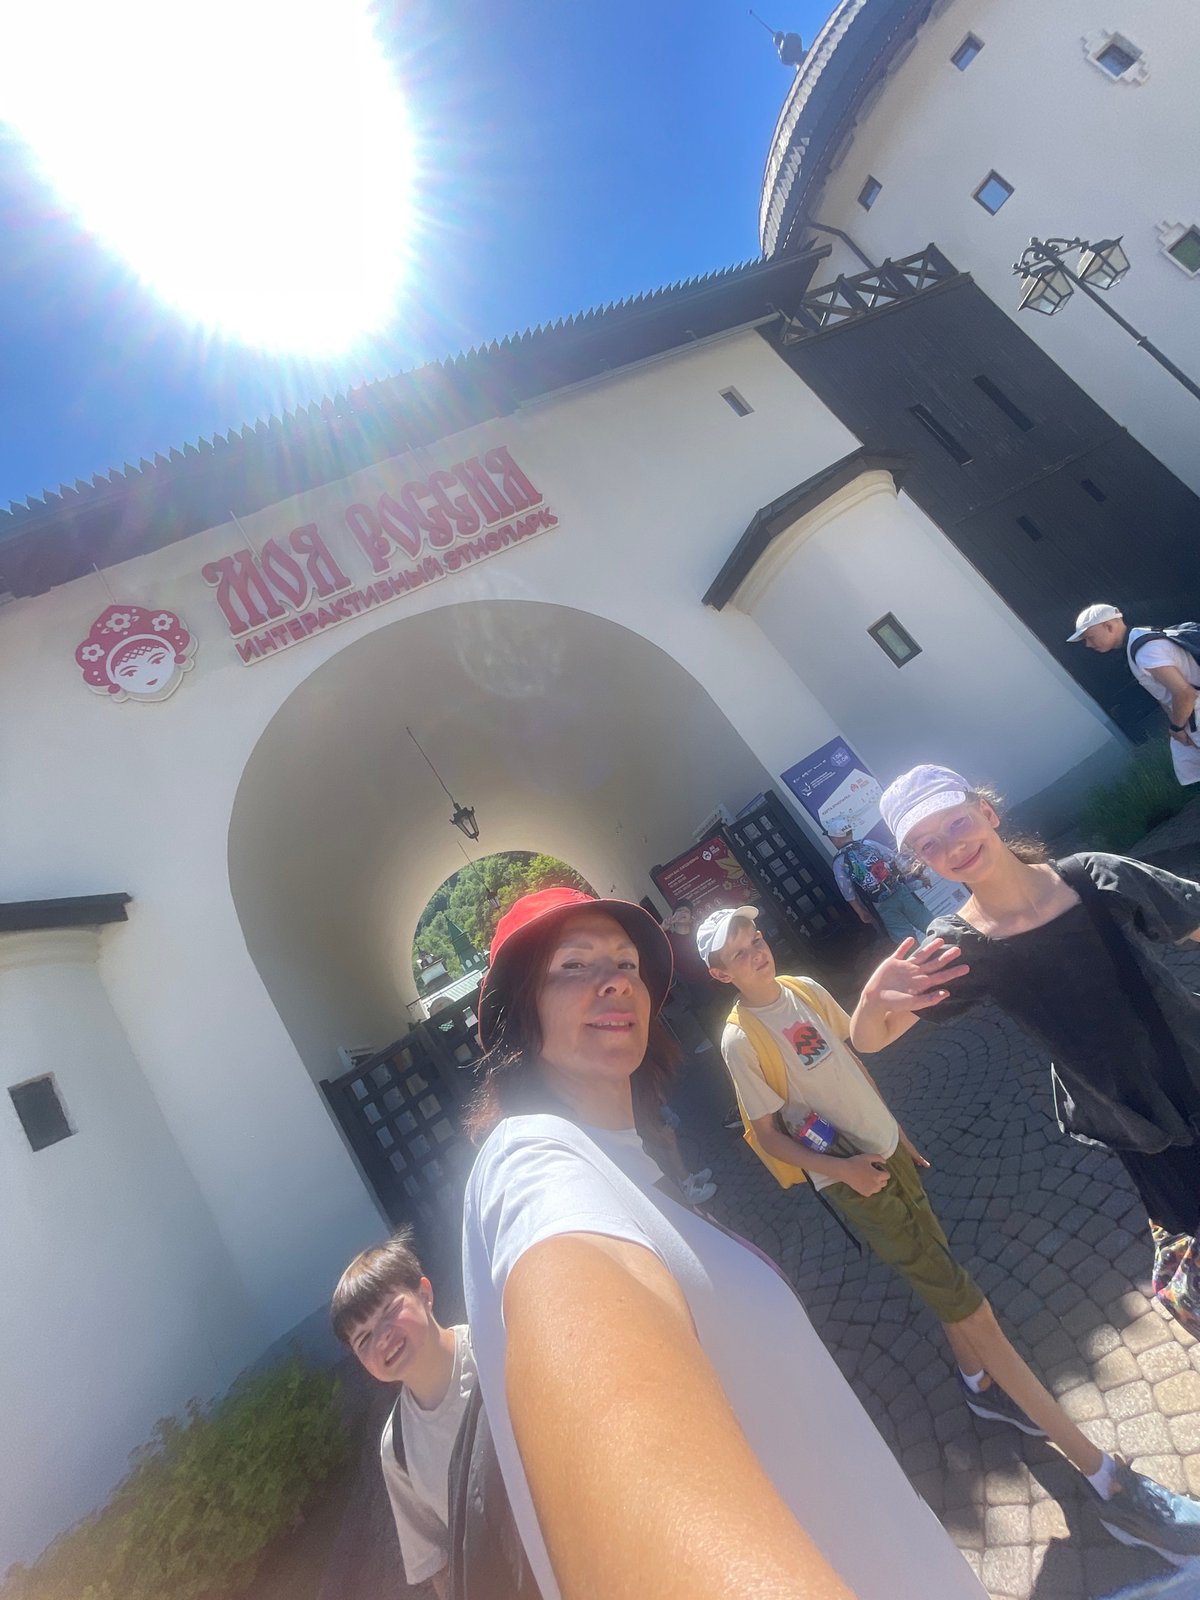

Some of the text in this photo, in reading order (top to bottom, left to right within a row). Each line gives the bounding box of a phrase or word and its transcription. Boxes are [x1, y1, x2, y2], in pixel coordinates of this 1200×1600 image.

[202, 445, 544, 637] МОЯ РОССИЯ
[234, 506, 559, 664] ИНТЕРАКТИВНЫЙ ЭТНОПАРК
